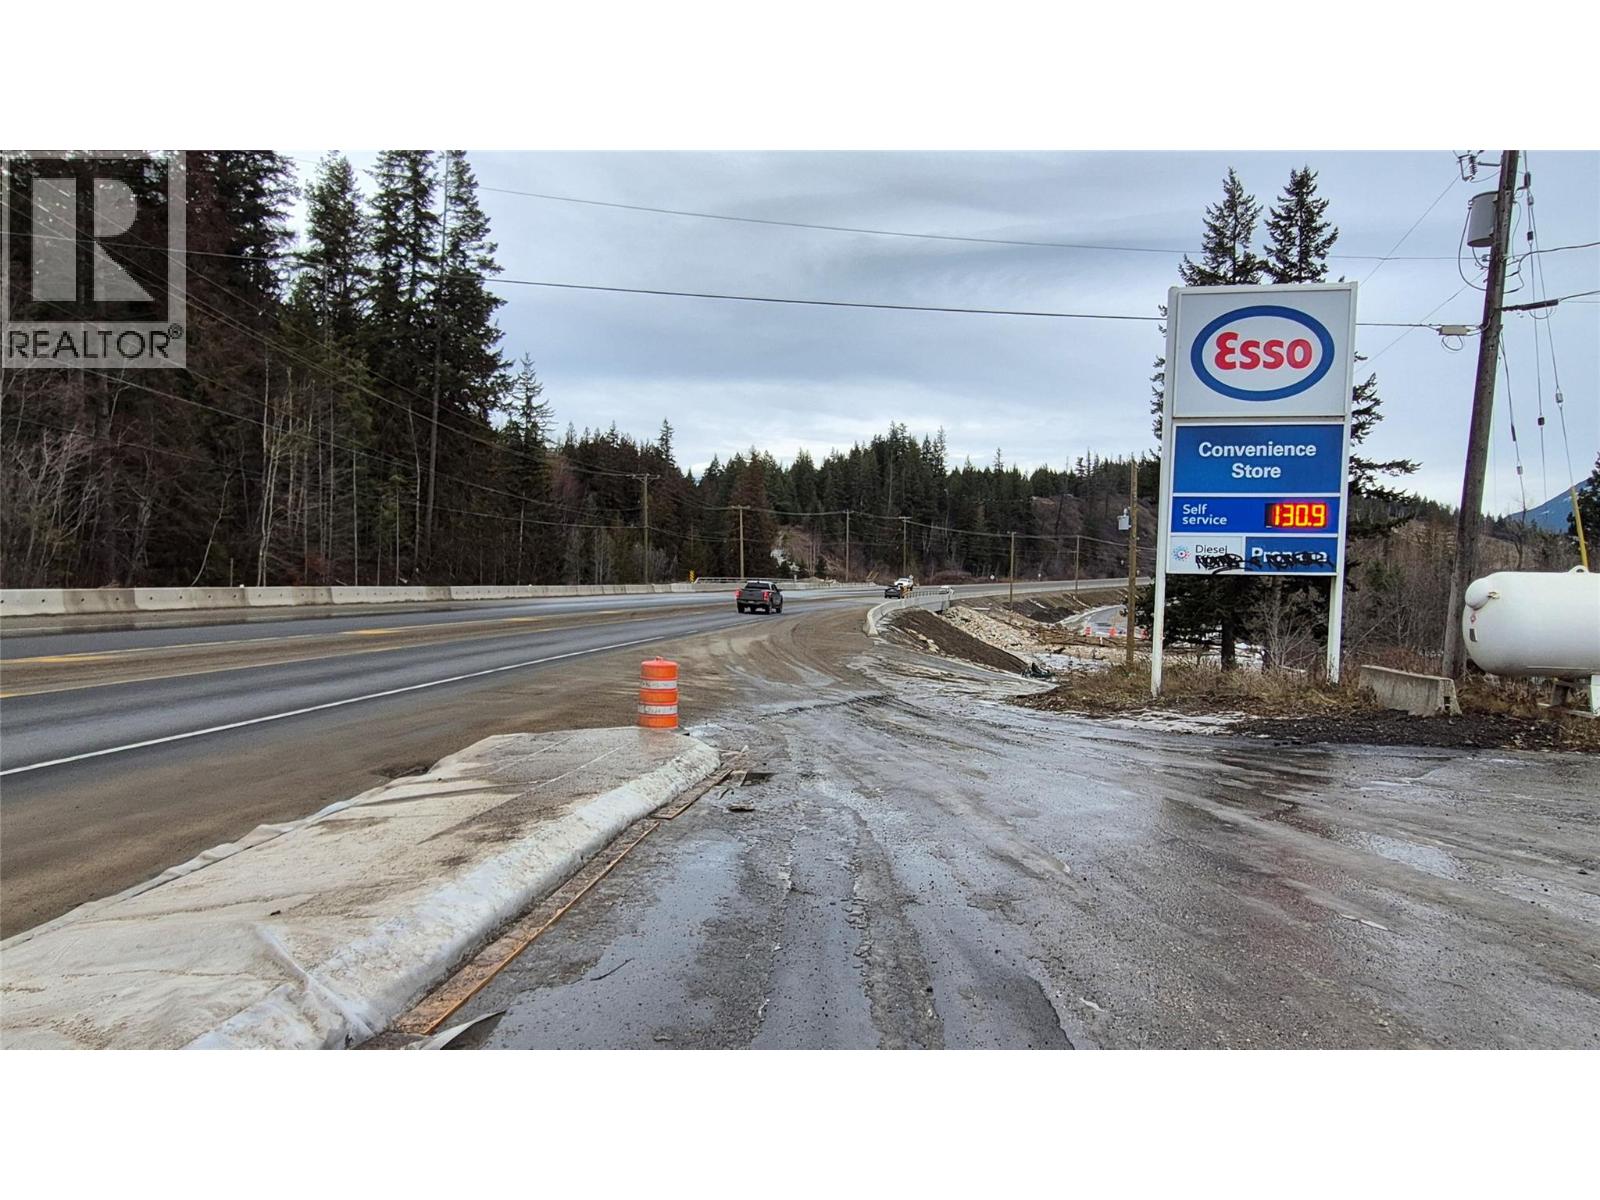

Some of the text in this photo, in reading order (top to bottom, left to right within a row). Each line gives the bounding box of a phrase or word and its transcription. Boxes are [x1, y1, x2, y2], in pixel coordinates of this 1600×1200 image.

[1214, 331, 1313, 371] Esso
[1198, 440, 1317, 458] Convenience
[1231, 463, 1282, 479] Store
[1182, 503, 1208, 514] Self
[1182, 514, 1228, 525] service
[1195, 545, 1228, 554] Diesel
